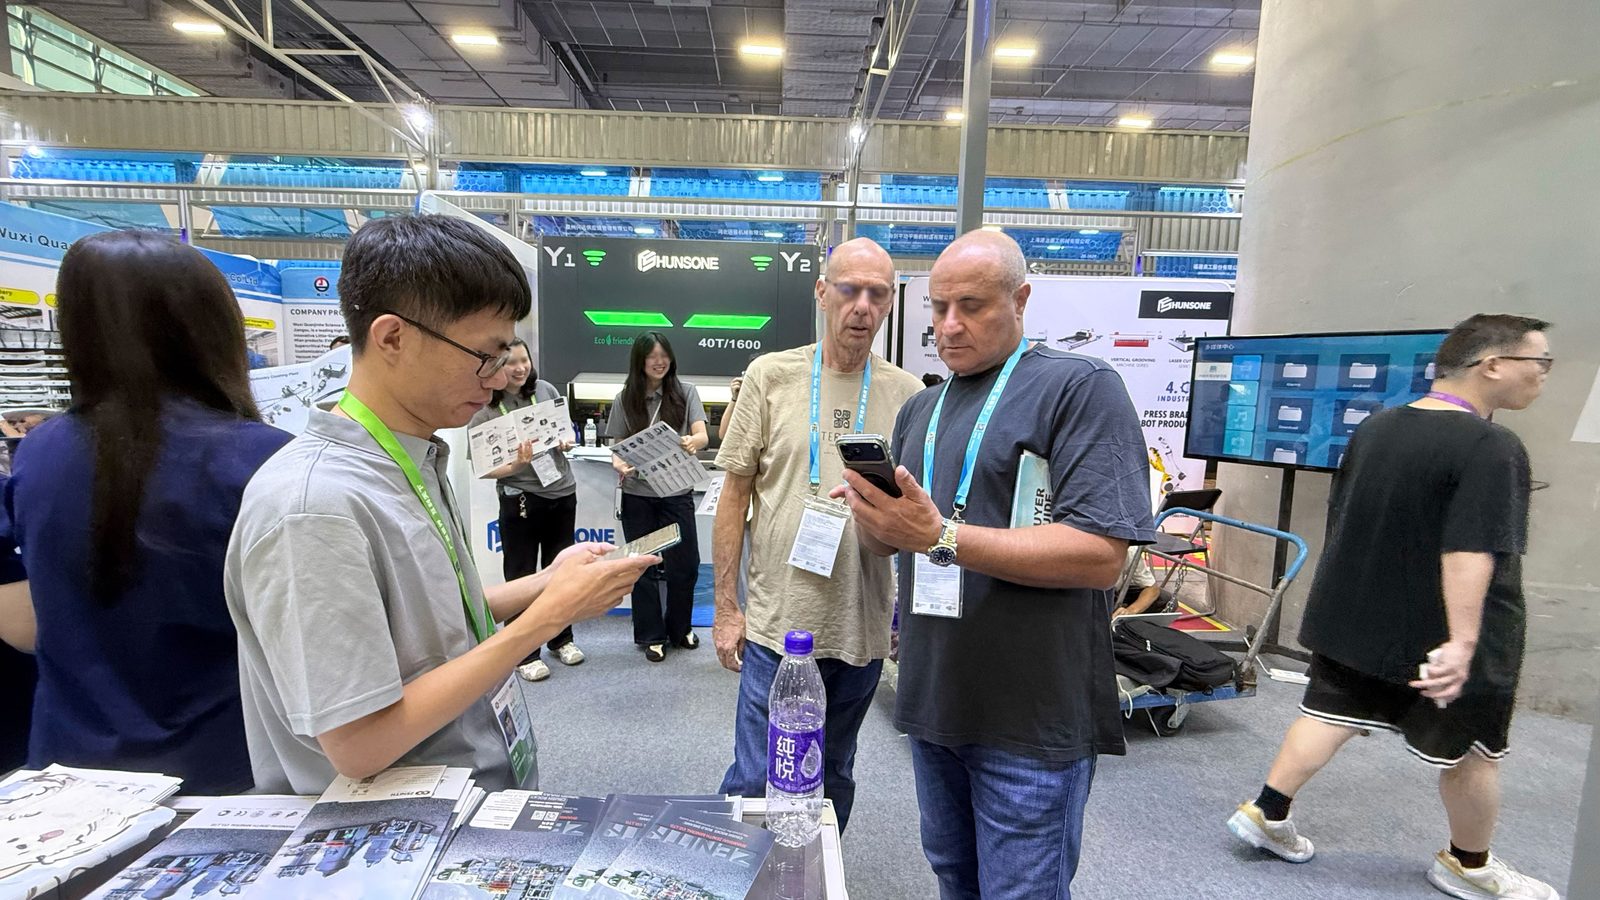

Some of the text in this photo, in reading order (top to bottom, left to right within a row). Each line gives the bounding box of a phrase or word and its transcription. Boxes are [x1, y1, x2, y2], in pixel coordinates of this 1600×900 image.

[38, 235, 73, 249] Qua
[544, 246, 576, 268] Y1
[780, 251, 811, 273] Y2
[1171, 301, 1213, 310] HUNSONE
[594, 336, 606, 345] Eco
[699, 338, 761, 349] 40T/1600
[1144, 410, 1167, 418] PRESS
[821, 431, 847, 441] TER
[574, 528, 615, 544] ONE
[775, 735, 796, 781] 纯悦
